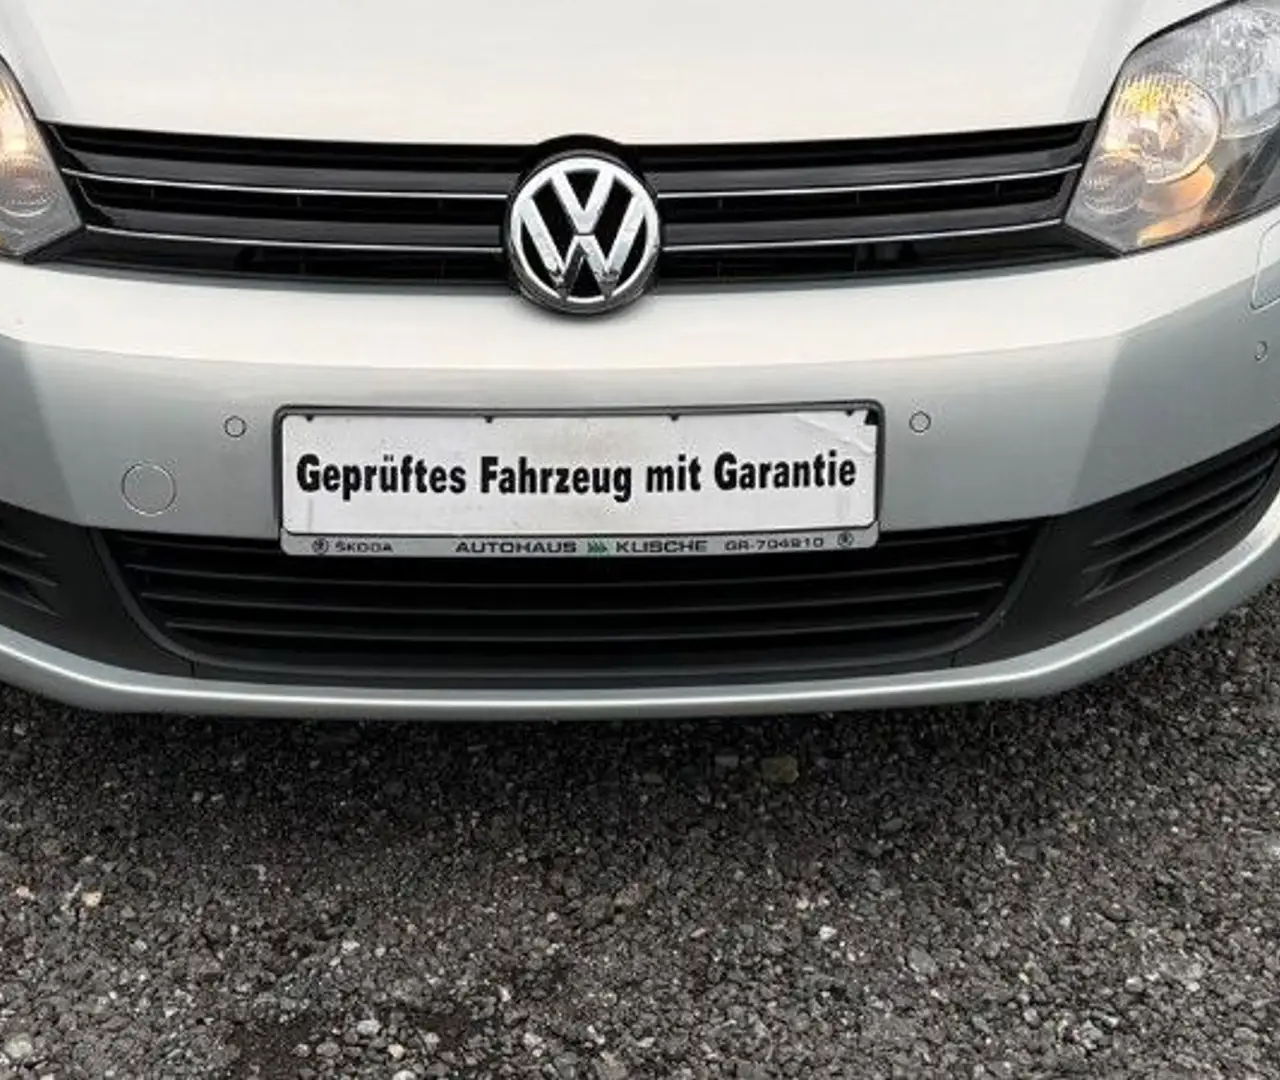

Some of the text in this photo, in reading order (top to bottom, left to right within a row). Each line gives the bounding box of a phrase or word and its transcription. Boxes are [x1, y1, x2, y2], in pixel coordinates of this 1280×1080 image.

[296, 449, 856, 503] Geprüftes Fahrzeug mit Garantie
[455, 540, 577, 554] AUTOHAUS
[615, 539, 709, 553] KLISCHE
